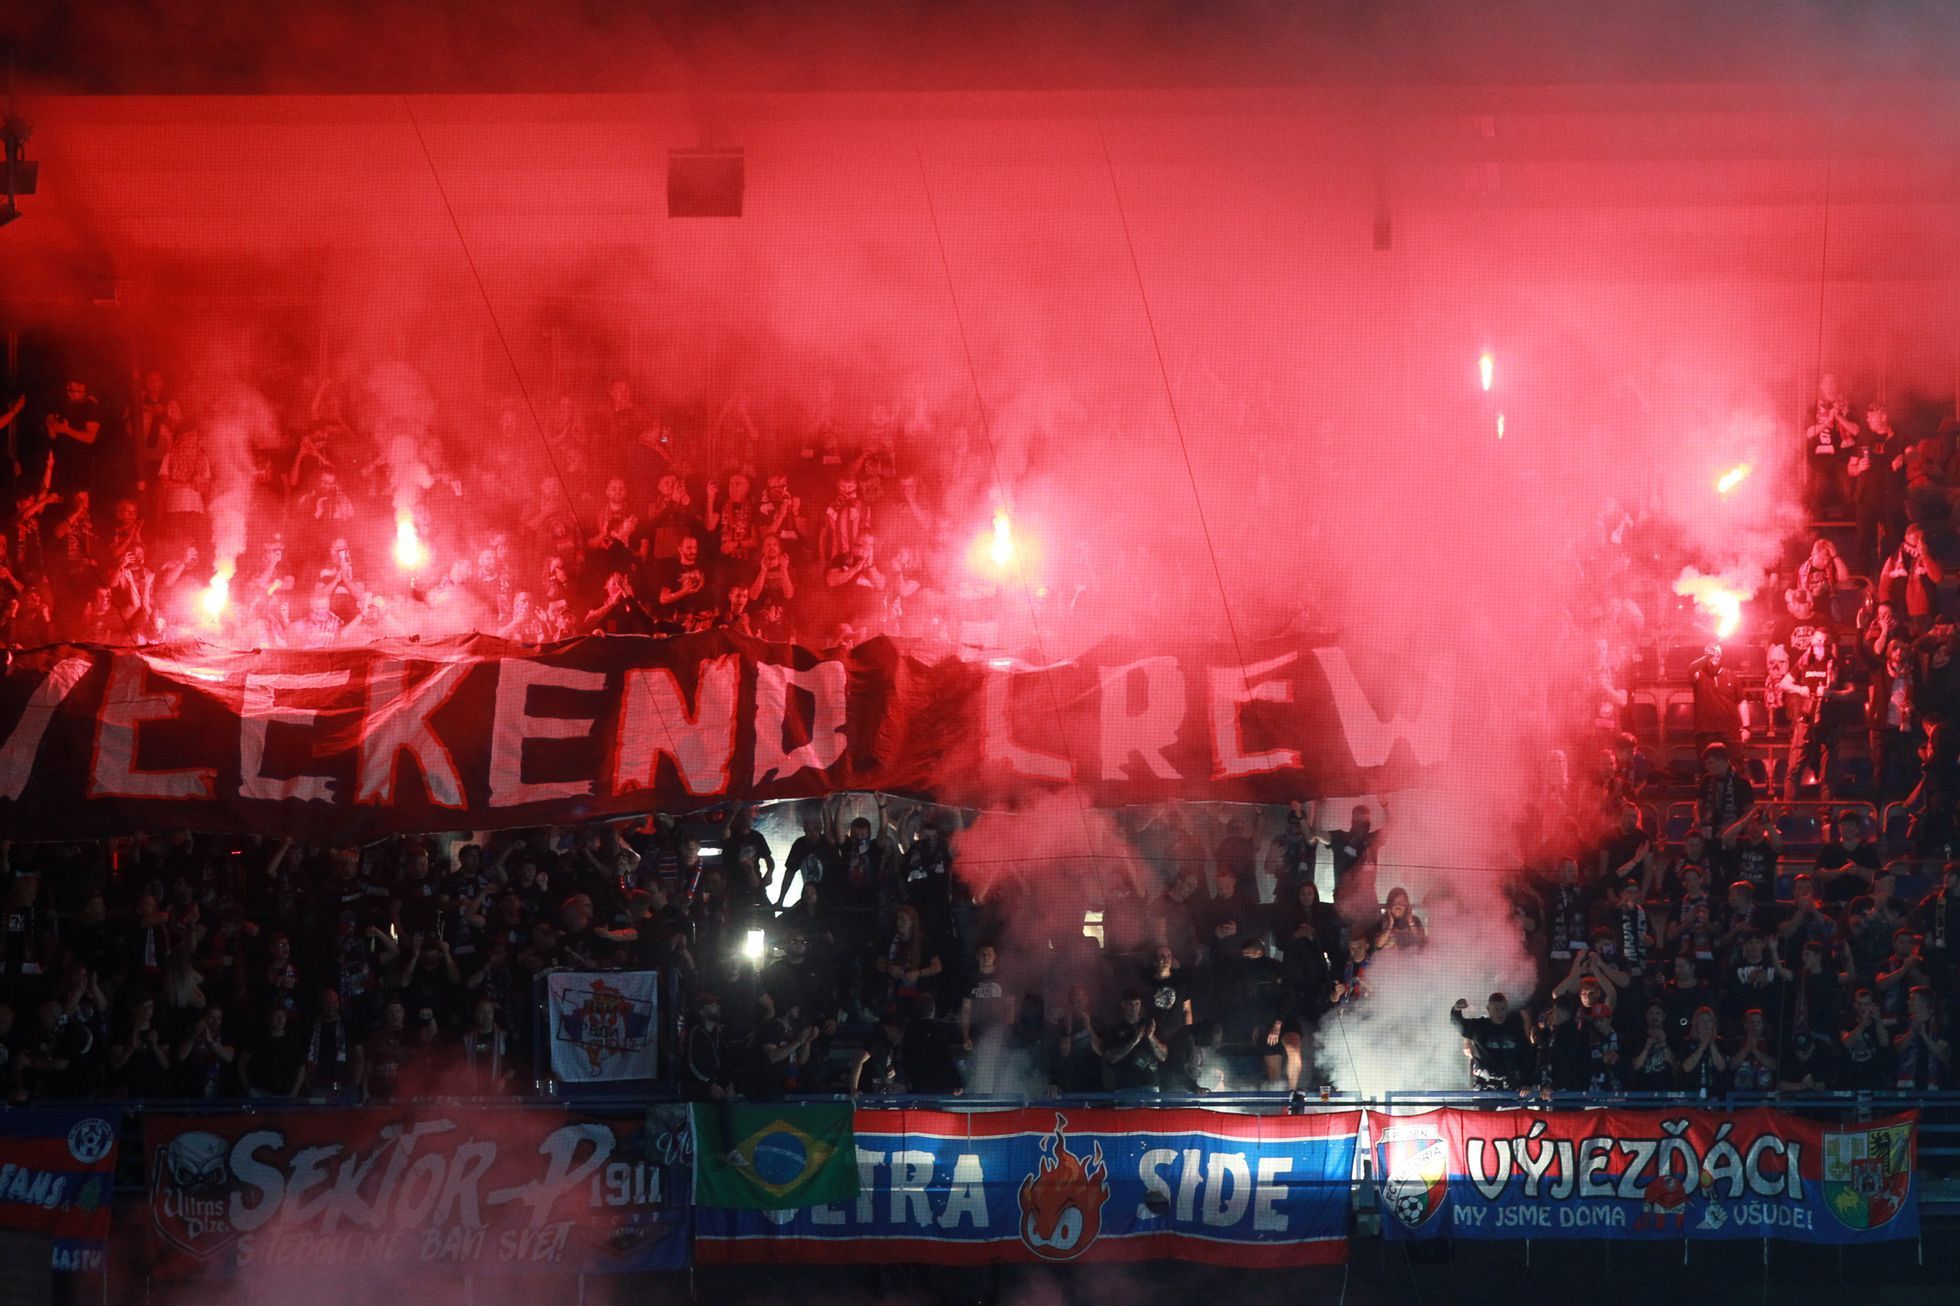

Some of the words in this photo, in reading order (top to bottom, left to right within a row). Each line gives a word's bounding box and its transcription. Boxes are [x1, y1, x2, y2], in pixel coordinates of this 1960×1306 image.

[981, 647, 1454, 783] CREW
[589, 1161, 662, 1207] 1911
[762, 1145, 989, 1228] TRA
[1136, 1149, 1293, 1231] SIDE
[1466, 1118, 1803, 1200] VÝJEZĎÁCI
[163, 1186, 225, 1218] Ultras
[1453, 1205, 1487, 1227] MY
[1495, 1204, 1552, 1227] JSME
[1559, 1206, 1627, 1228] DOMA
[1733, 1200, 1814, 1230] VŠUDE!
